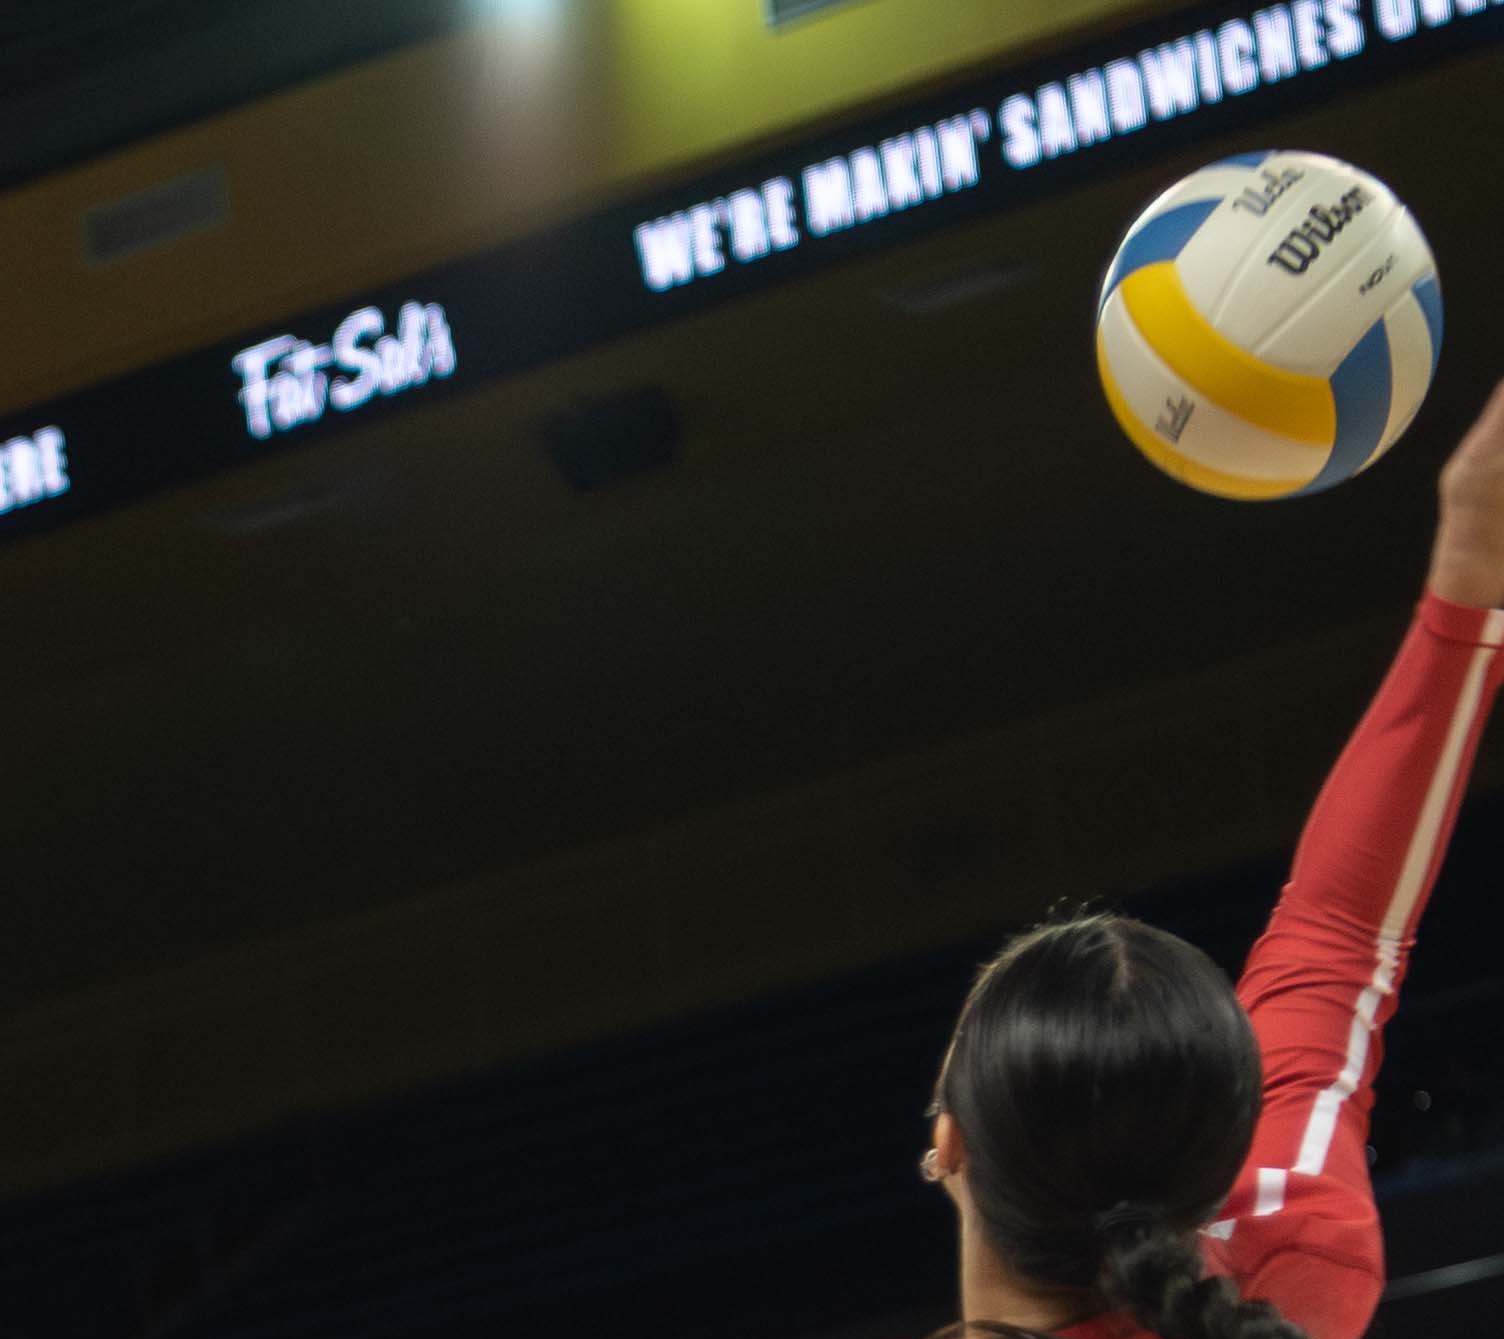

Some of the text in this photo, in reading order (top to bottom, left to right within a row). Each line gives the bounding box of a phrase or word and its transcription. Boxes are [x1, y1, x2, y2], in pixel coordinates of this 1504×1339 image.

[633, 0, 1365, 293] WE'RE MAKIN' SANDWICHES
[1268, 183, 1376, 277] Wilson
[231, 333, 333, 440] Fat
